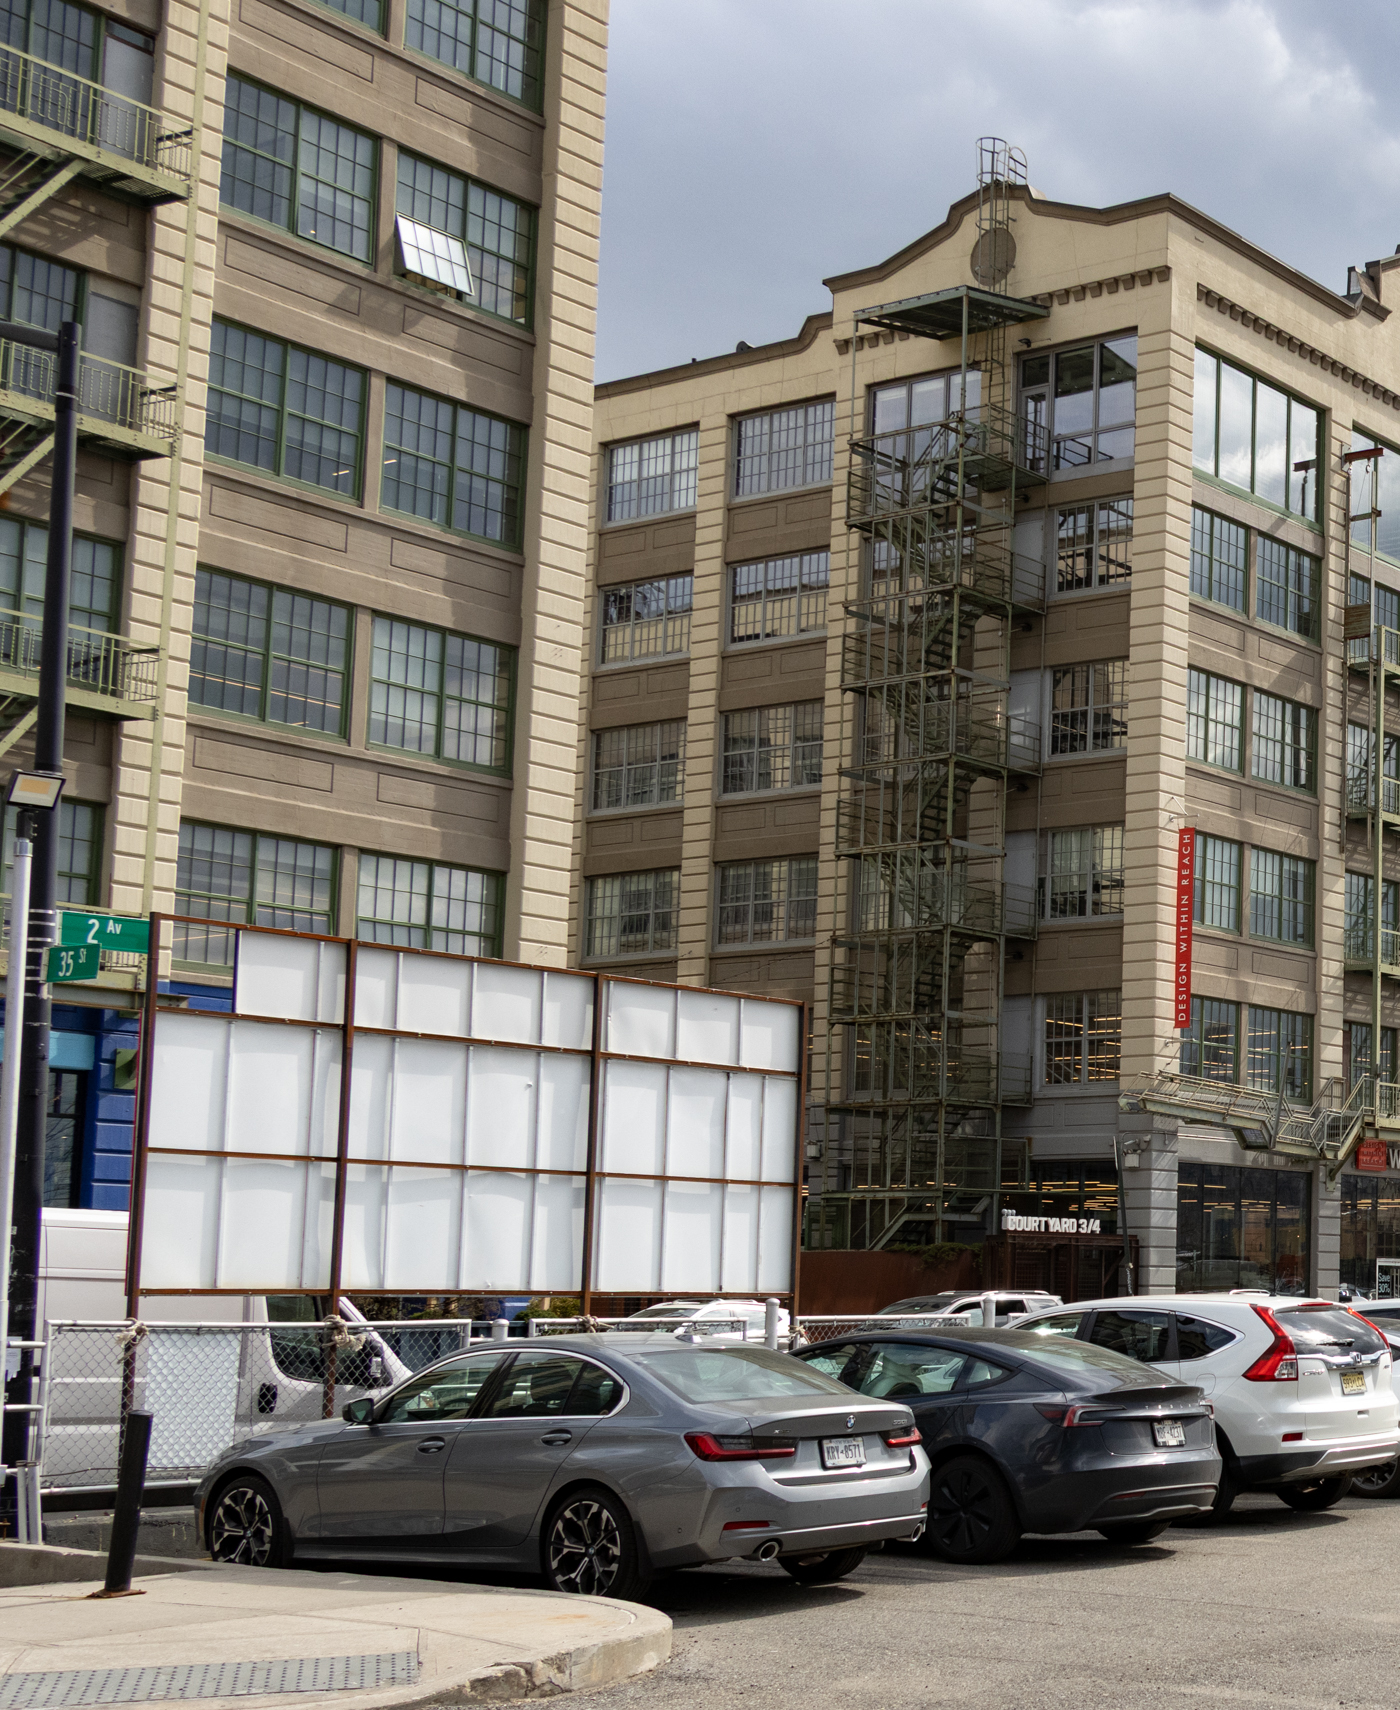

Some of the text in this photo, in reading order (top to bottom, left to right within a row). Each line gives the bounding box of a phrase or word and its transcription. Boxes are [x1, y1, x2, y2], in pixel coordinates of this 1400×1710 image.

[87, 919, 123, 943] 2 Av
[1178, 834, 1191, 1021] DESIGN WITHIN REACH
[58, 950, 87, 977] 35 St
[1007, 1215, 1101, 1234] COURTYARD 3/4
